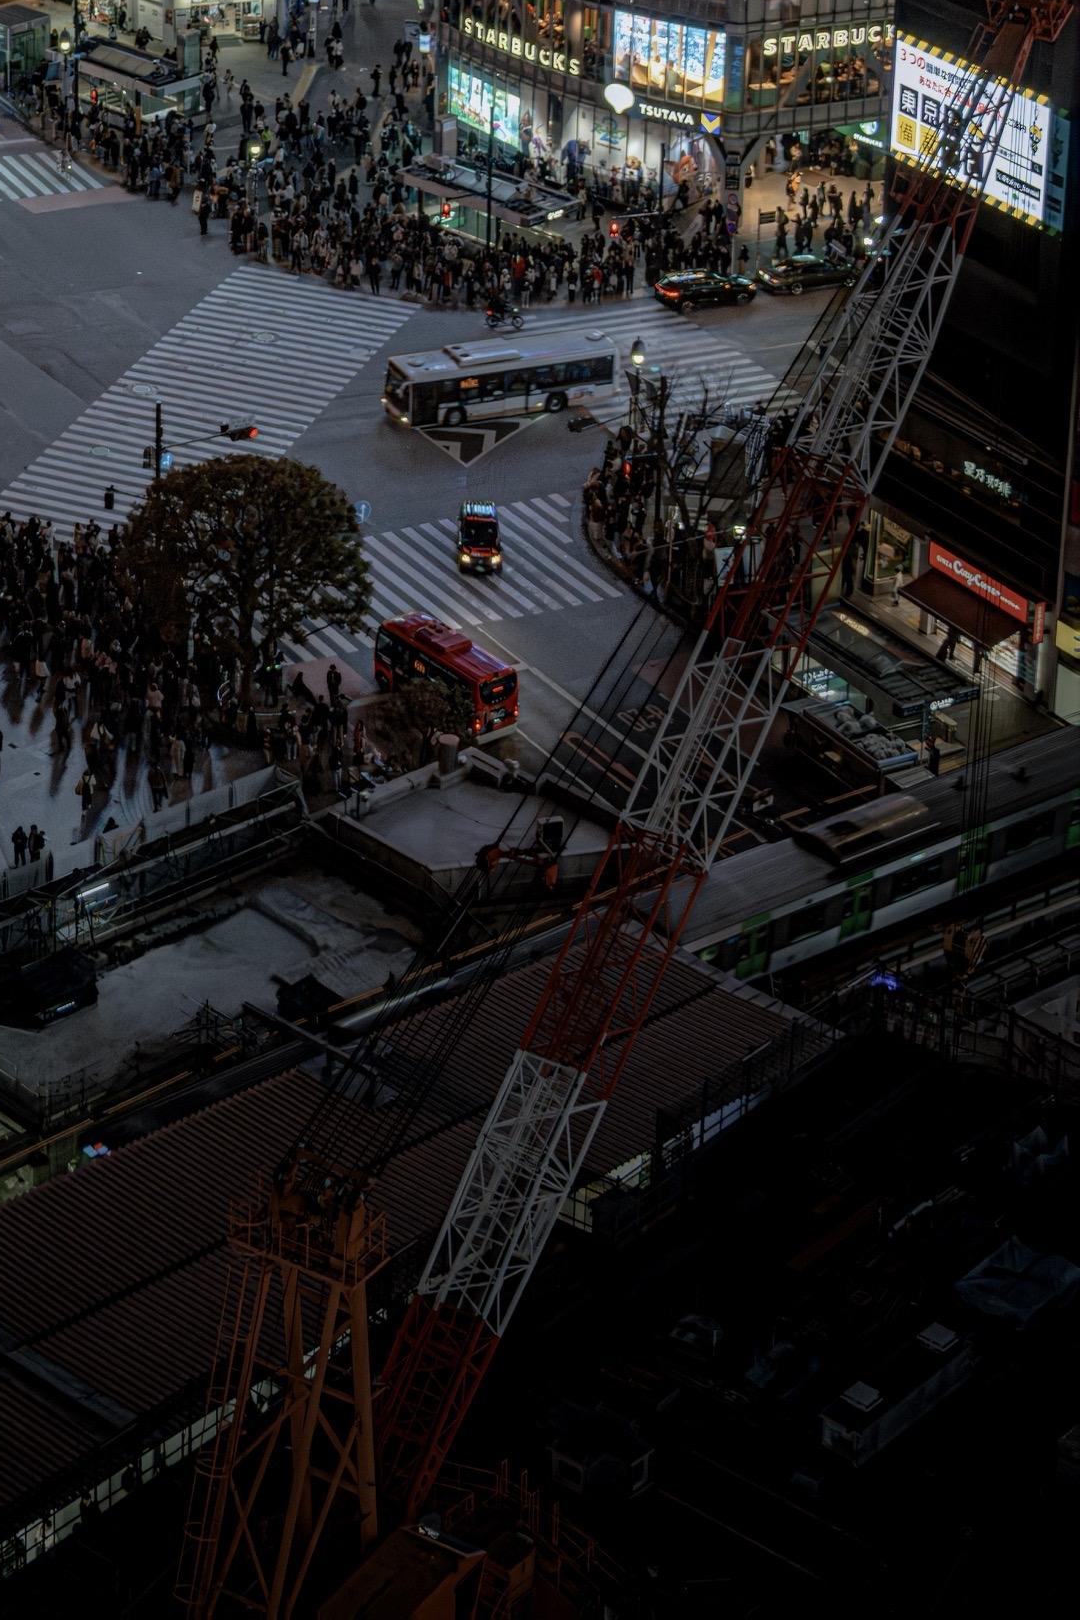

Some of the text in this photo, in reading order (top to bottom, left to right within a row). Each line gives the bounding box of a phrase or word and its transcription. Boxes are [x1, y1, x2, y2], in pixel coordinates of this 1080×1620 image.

[464, 17, 581, 76] STARBUCKS
[763, 23, 895, 56] STARBUCK
[639, 103, 694, 126] TSUTAYA
[853, 131, 883, 148] STARBUCKS
